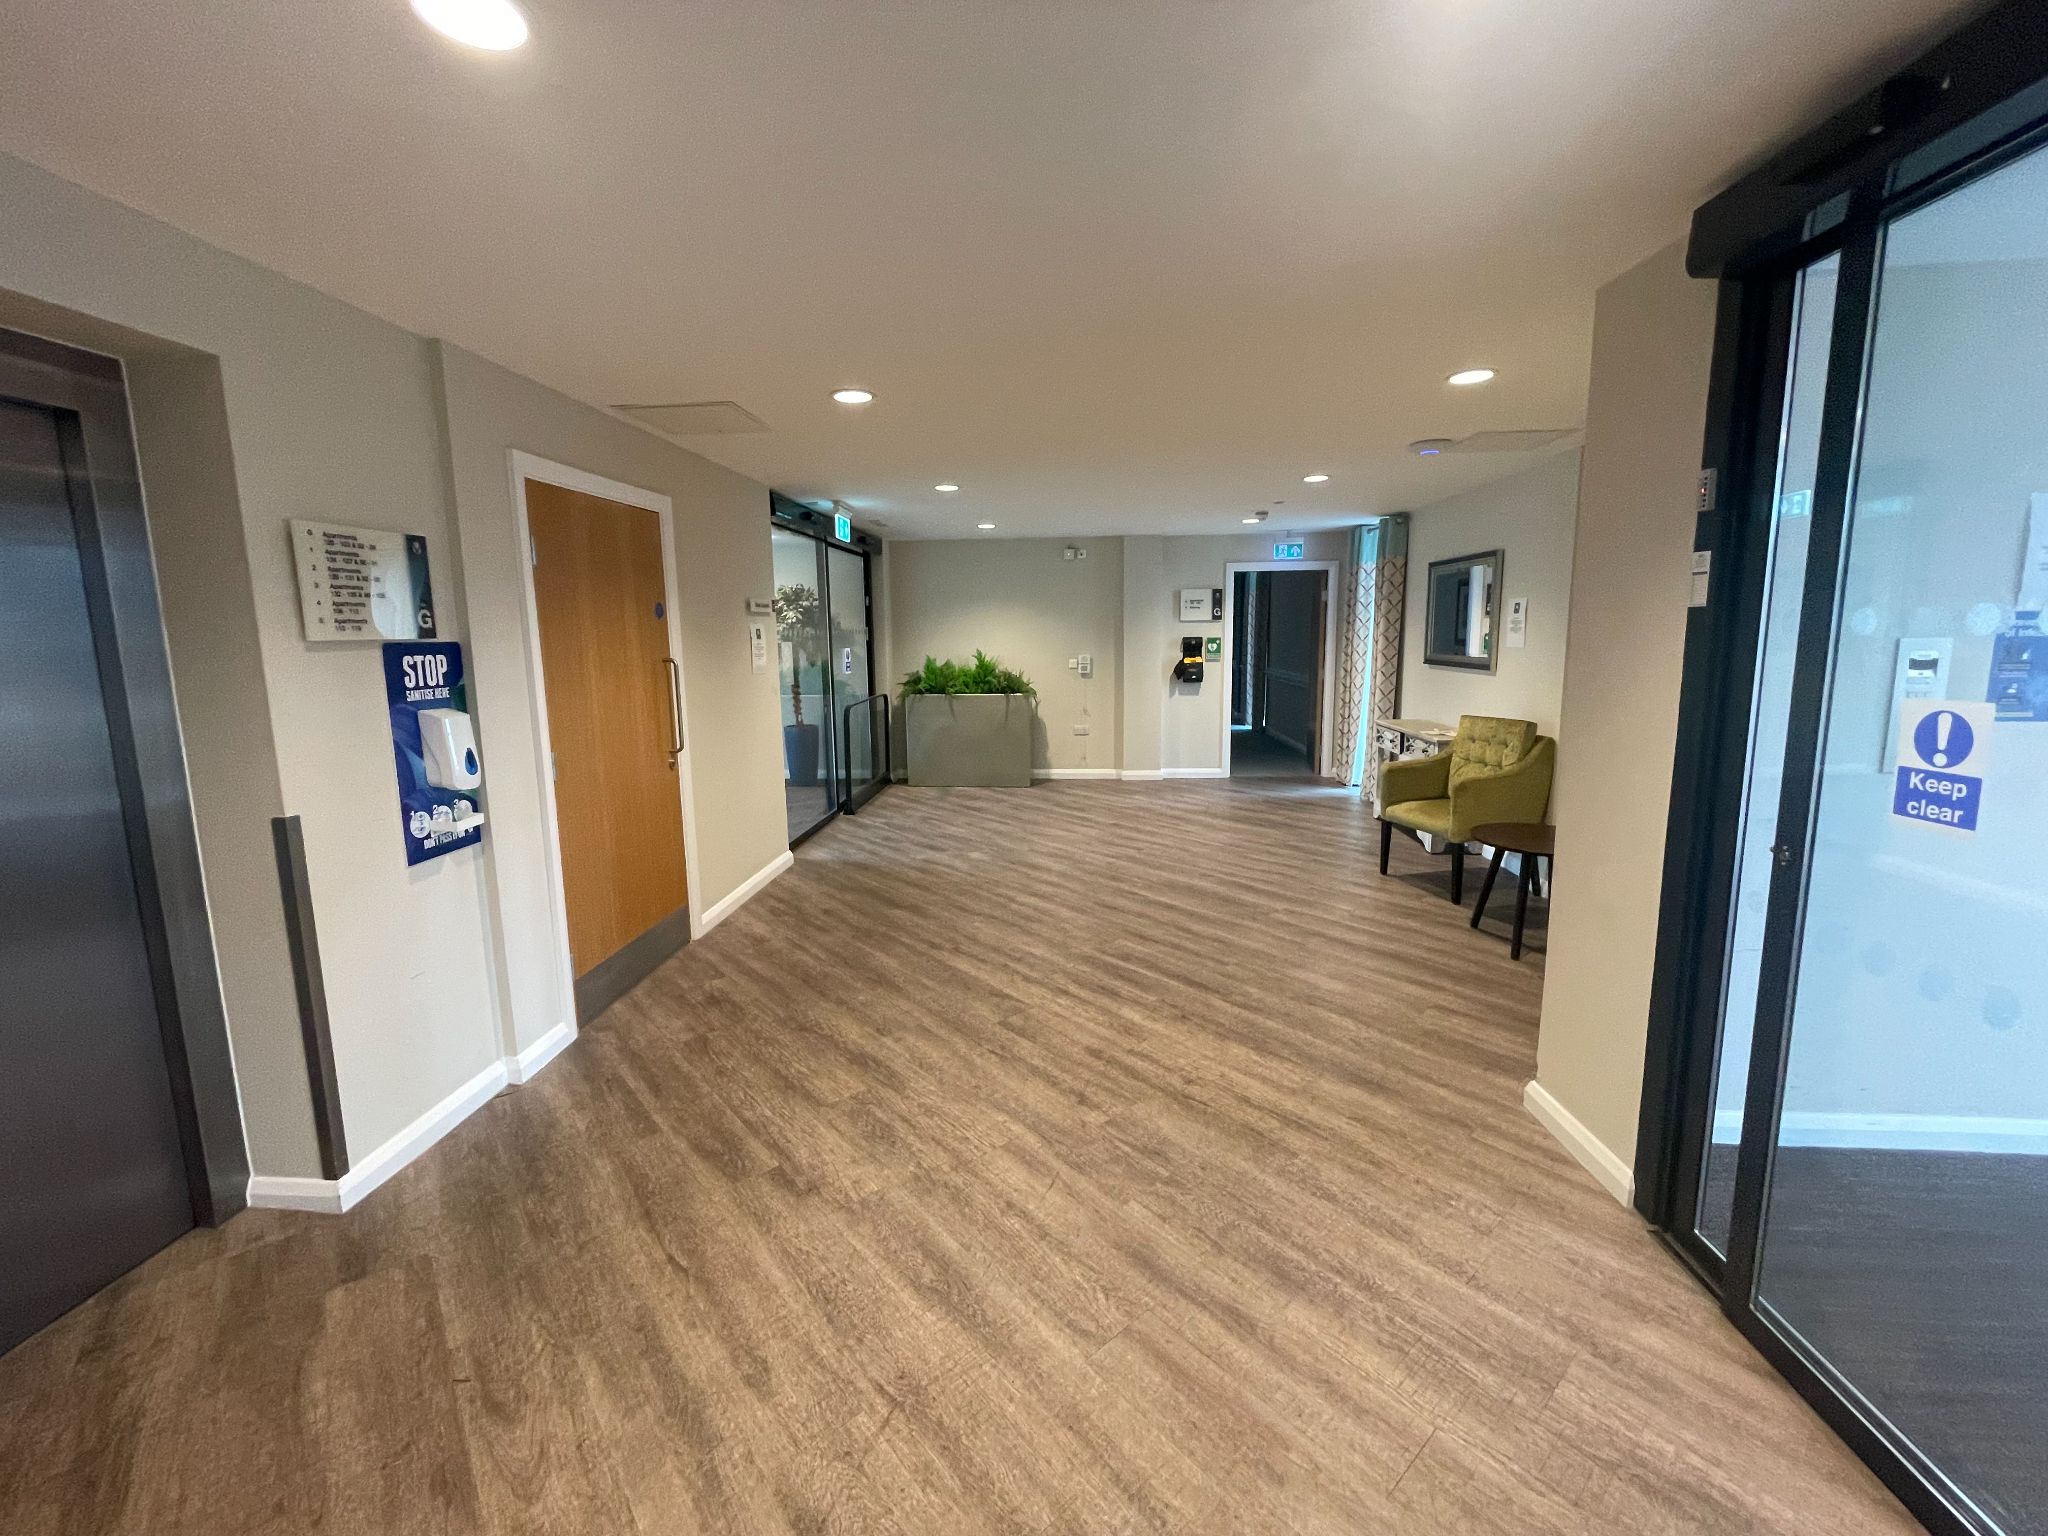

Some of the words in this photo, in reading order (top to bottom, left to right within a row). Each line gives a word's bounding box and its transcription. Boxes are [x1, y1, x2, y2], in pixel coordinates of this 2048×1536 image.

[418, 609, 432, 628] G
[1213, 608, 1221, 616] G
[402, 655, 448, 688] STOP
[405, 688, 434, 701] SANITISE
[434, 687, 451, 699] HERE
[1909, 771, 1968, 801] Keep
[1906, 799, 1964, 823] clear
